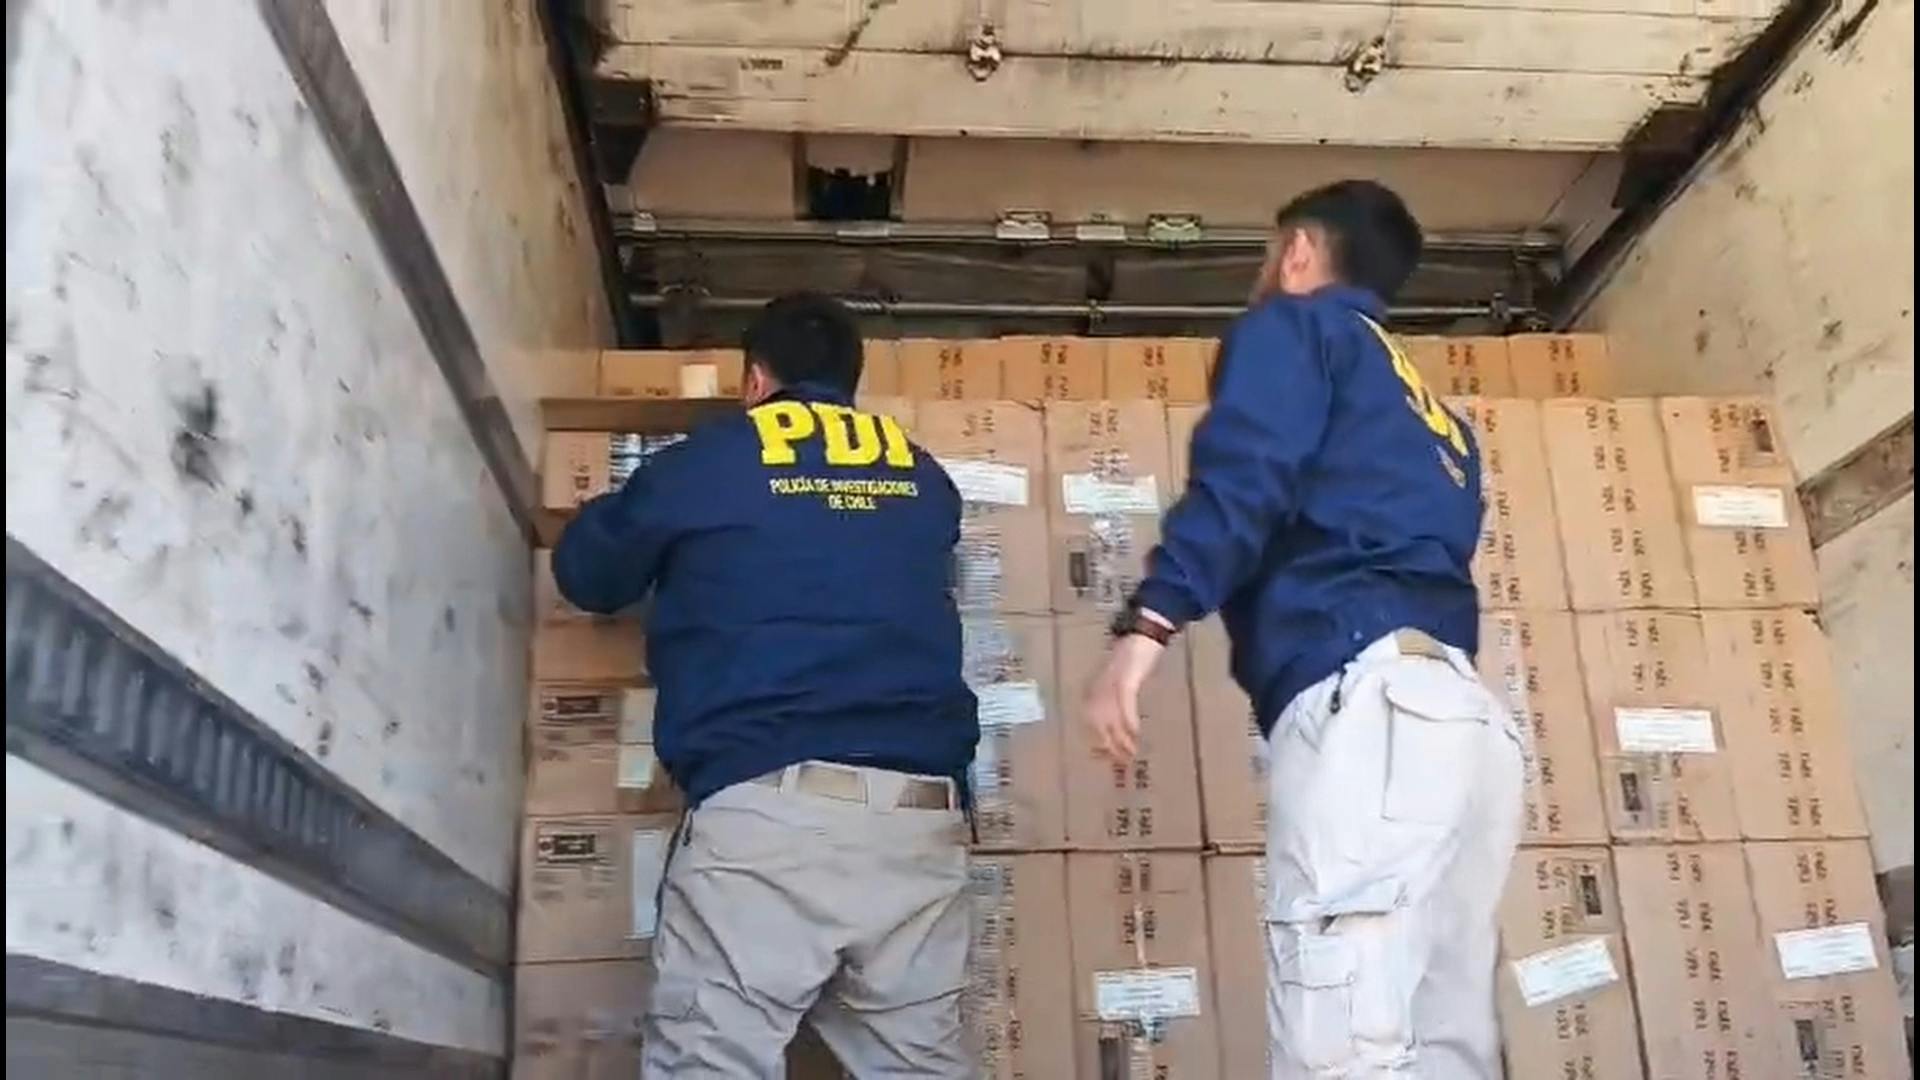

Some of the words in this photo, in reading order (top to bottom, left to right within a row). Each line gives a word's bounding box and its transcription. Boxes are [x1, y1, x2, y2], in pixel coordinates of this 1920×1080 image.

[747, 400, 915, 467] PDI
[814, 478, 829, 493] DE
[827, 494, 844, 511] DE
[845, 495, 877, 511] CHILE
